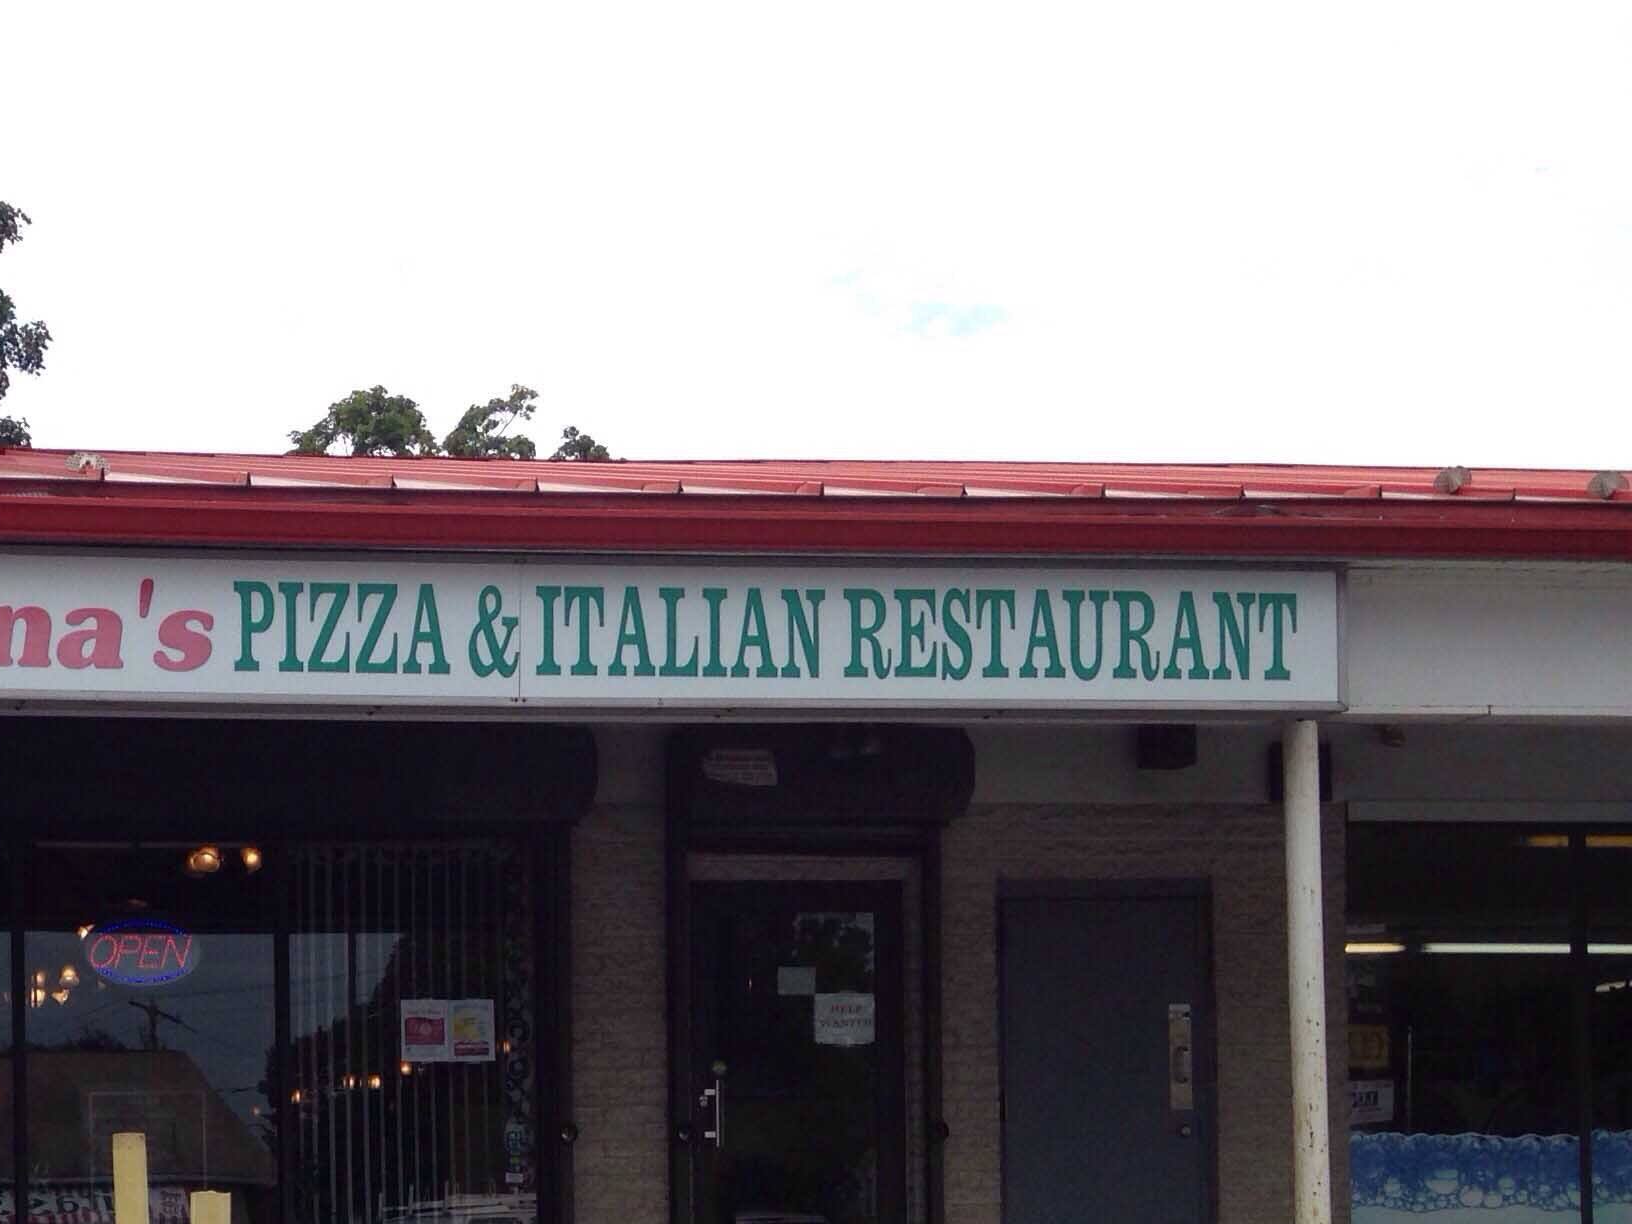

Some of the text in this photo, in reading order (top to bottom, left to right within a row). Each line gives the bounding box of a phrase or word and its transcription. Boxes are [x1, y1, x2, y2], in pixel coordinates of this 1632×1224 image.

[232, 580, 452, 677] PIZZA
[467, 584, 520, 678] &
[534, 585, 827, 678] ITALIAN
[842, 587, 1299, 681] RESTAURANT
[87, 933, 193, 970] OPEN
